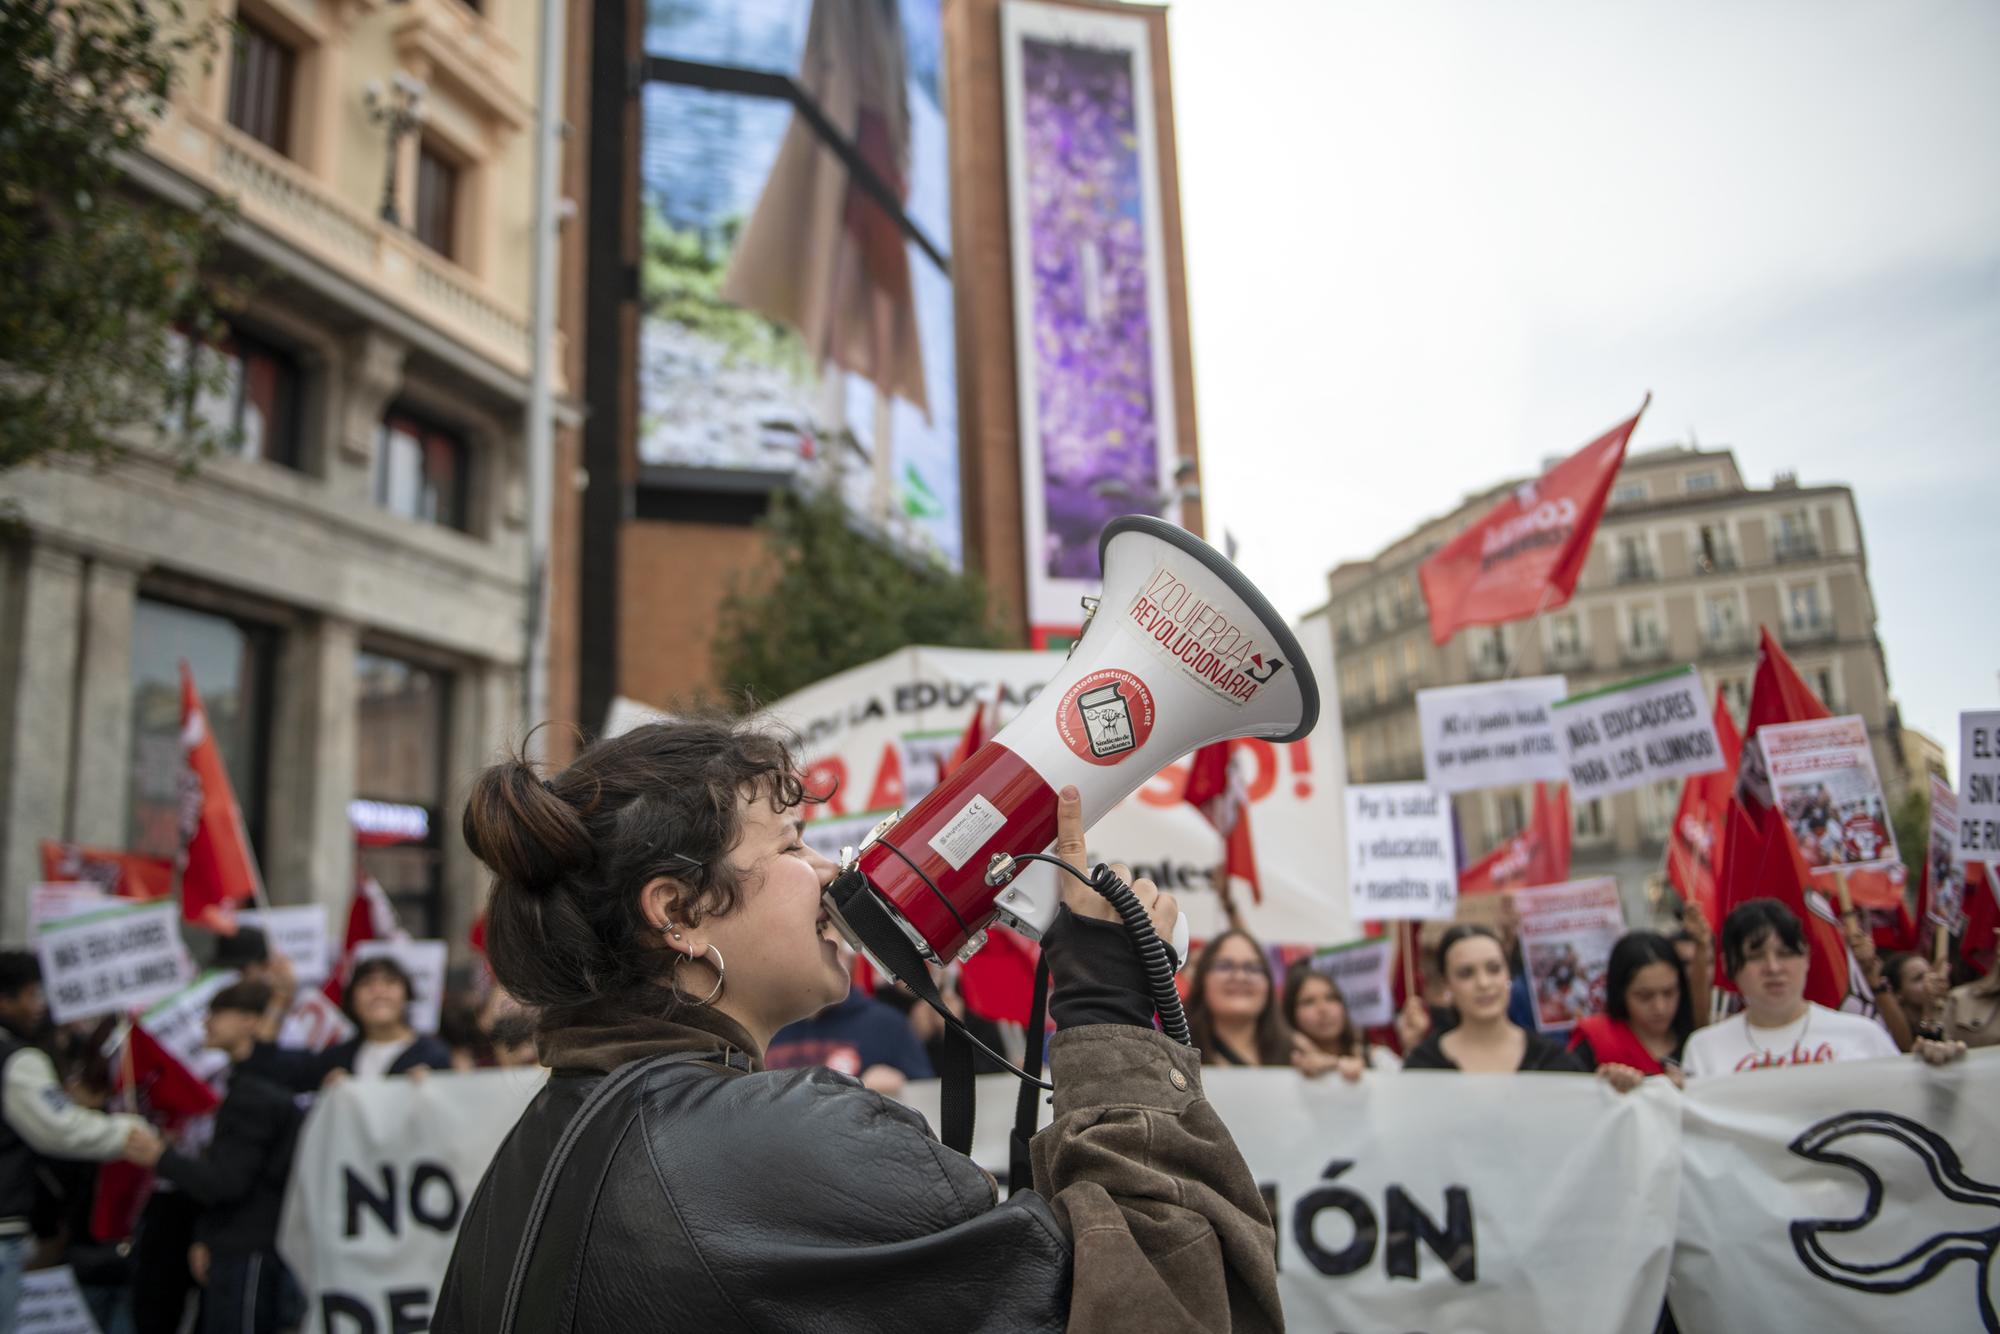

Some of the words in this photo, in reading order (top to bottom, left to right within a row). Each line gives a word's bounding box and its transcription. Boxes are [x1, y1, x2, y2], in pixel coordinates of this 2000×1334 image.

[1130, 597, 1258, 702] REVOLUCIONARIA
[1146, 569, 1253, 668] IZQUIERDA
[1059, 671, 1151, 747] www.sindicatodeestudiantes.net
[1095, 736, 1122, 747] Sindicato
[1098, 741, 1131, 753] Estudiantes
[341, 1161, 463, 1240] NO
